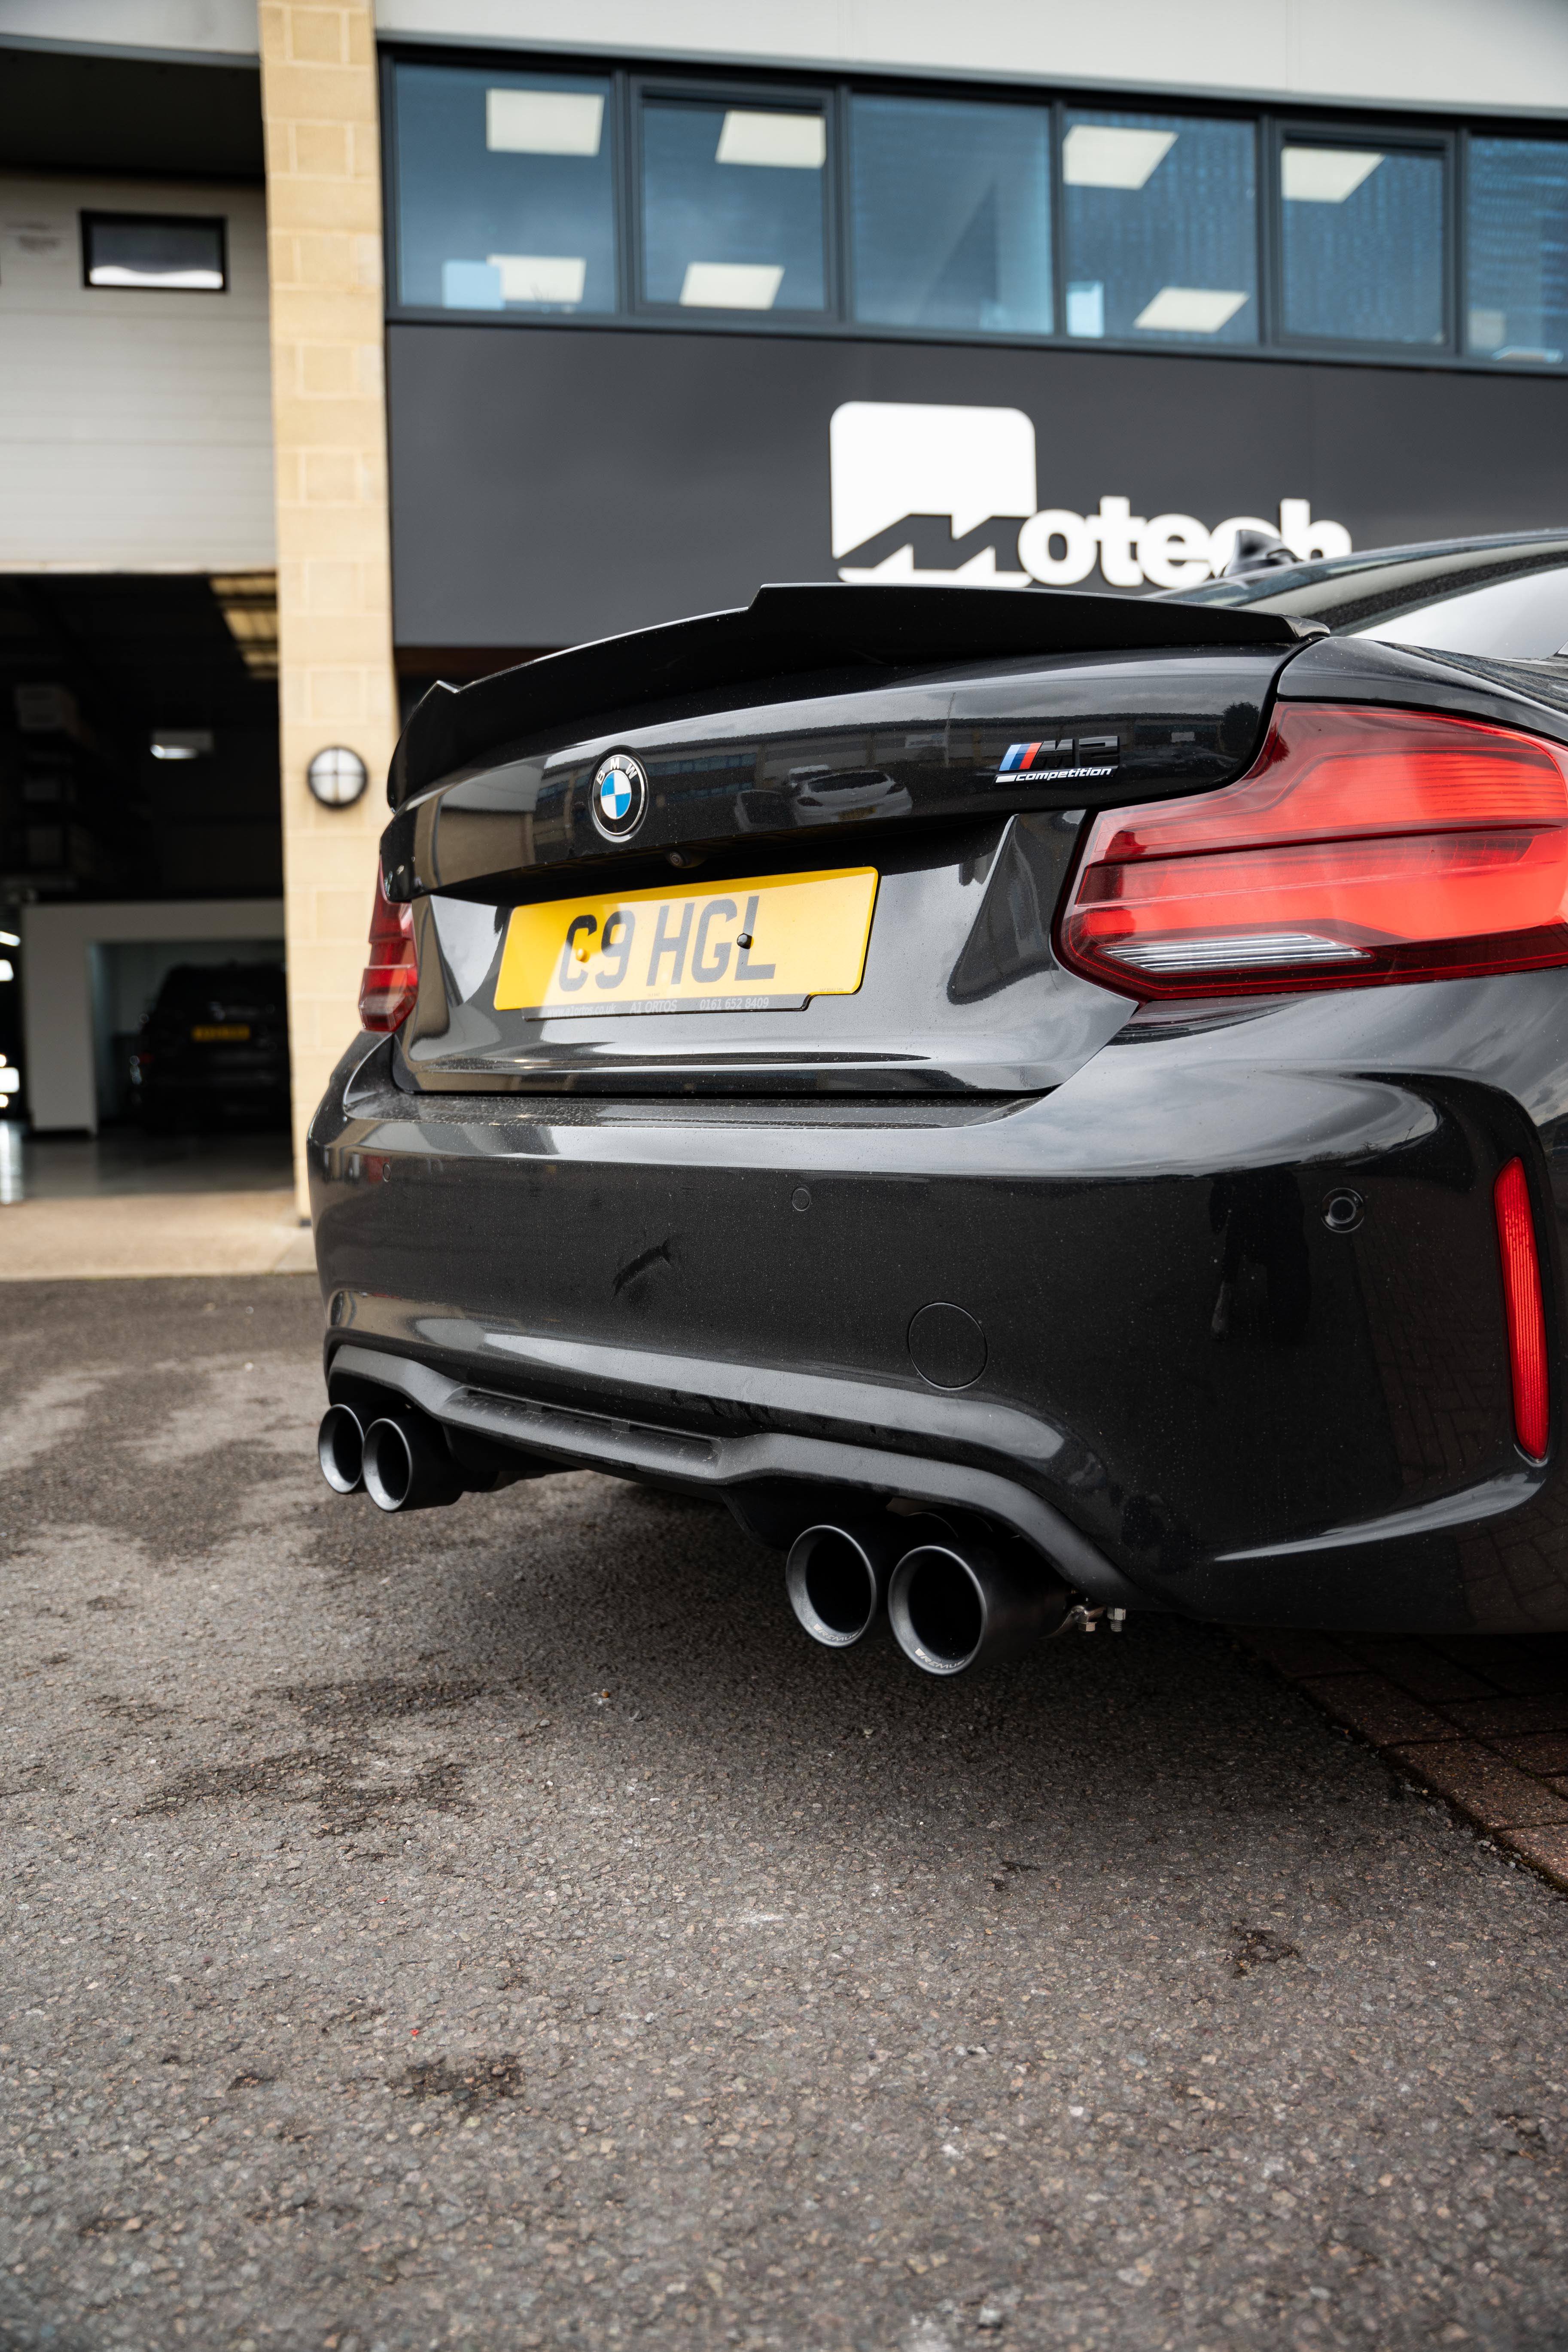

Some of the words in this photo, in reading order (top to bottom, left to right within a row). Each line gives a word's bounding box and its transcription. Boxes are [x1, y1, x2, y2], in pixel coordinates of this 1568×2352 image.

[1032, 736, 1119, 768] M2
[596, 757, 638, 785] BMW
[1016, 767, 1112, 782] competition
[558, 910, 636, 992] C9
[646, 895, 776, 986] HGL
[645, 999, 678, 1013] ORTOS
[700, 999, 722, 1010] 0161
[725, 998, 742, 1009] 652
[745, 997, 769, 1008] 8409
